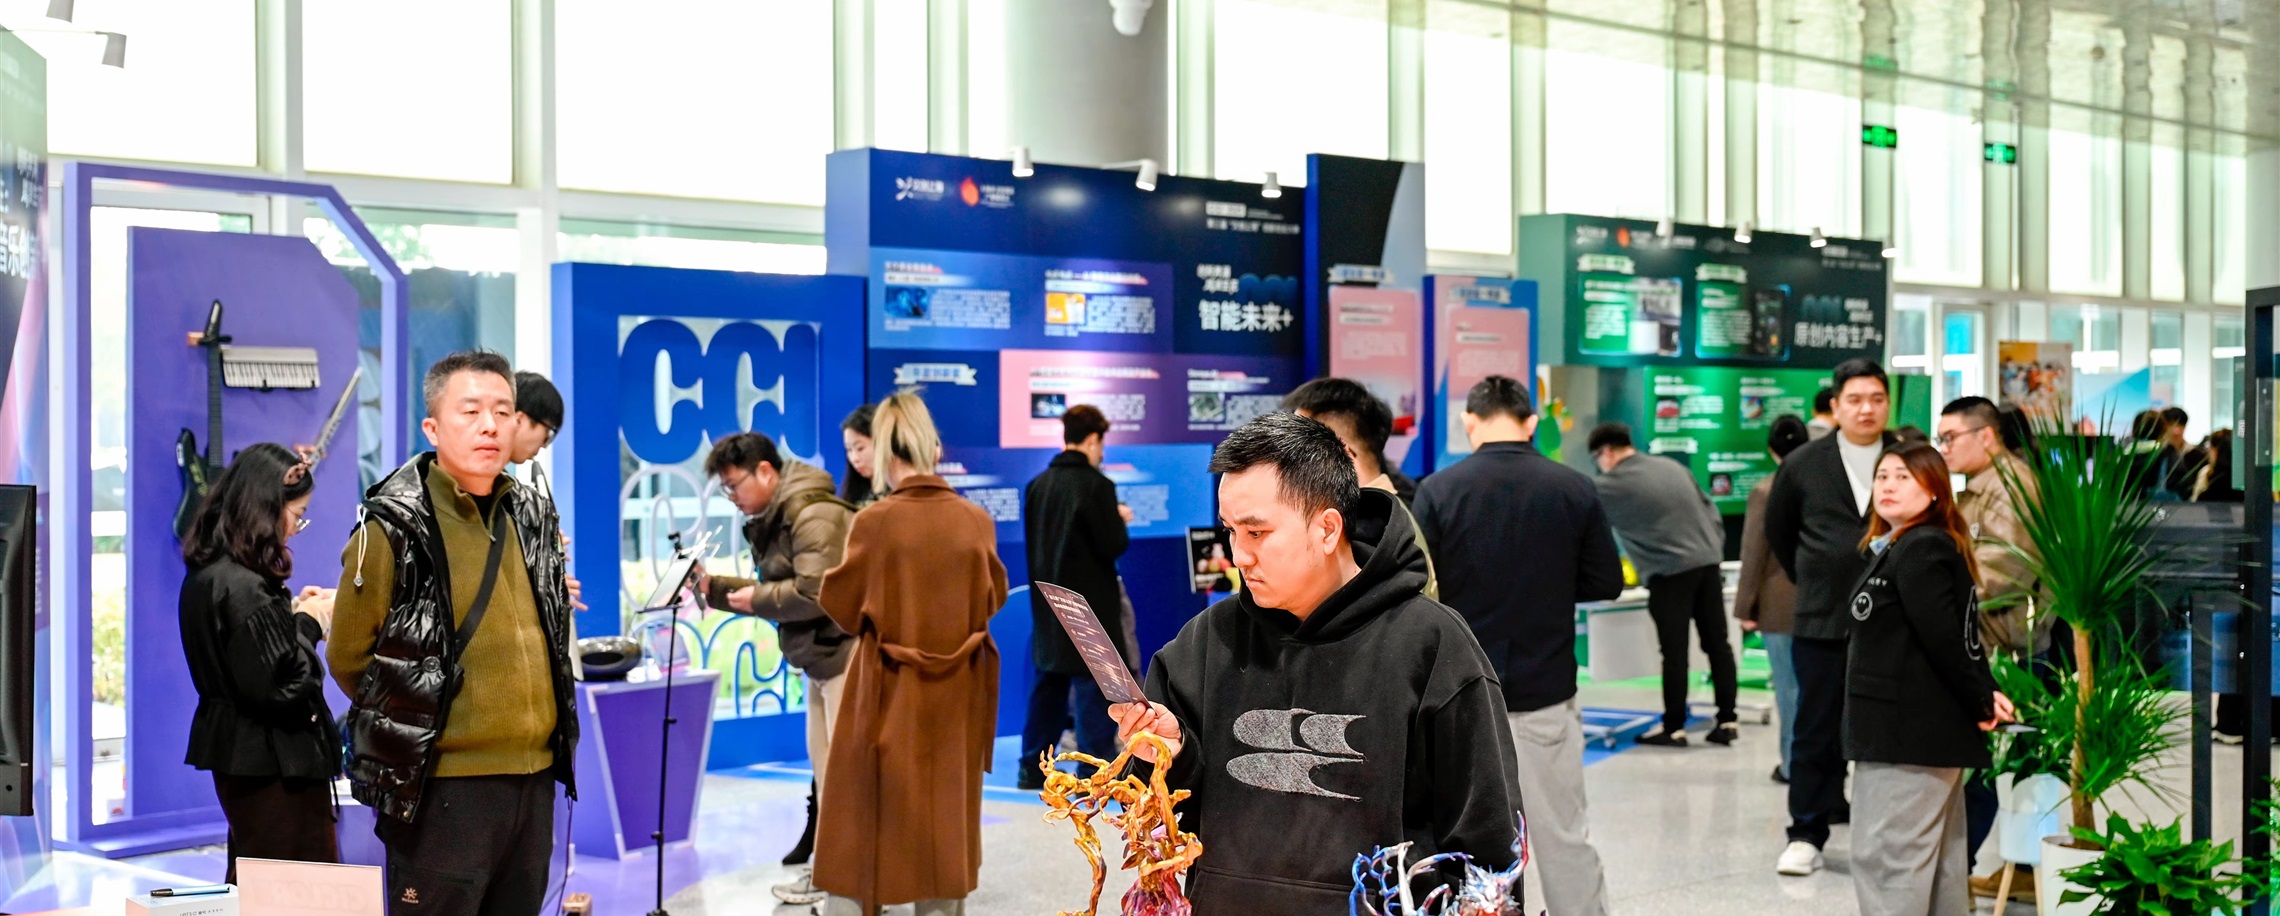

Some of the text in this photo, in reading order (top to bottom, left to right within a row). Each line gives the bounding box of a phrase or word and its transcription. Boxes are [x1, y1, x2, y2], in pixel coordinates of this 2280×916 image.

[1198, 299, 1294, 333] 智能未来+
[1794, 321, 1883, 349] 原创内容生产+
[620, 319, 818, 464] CCI
